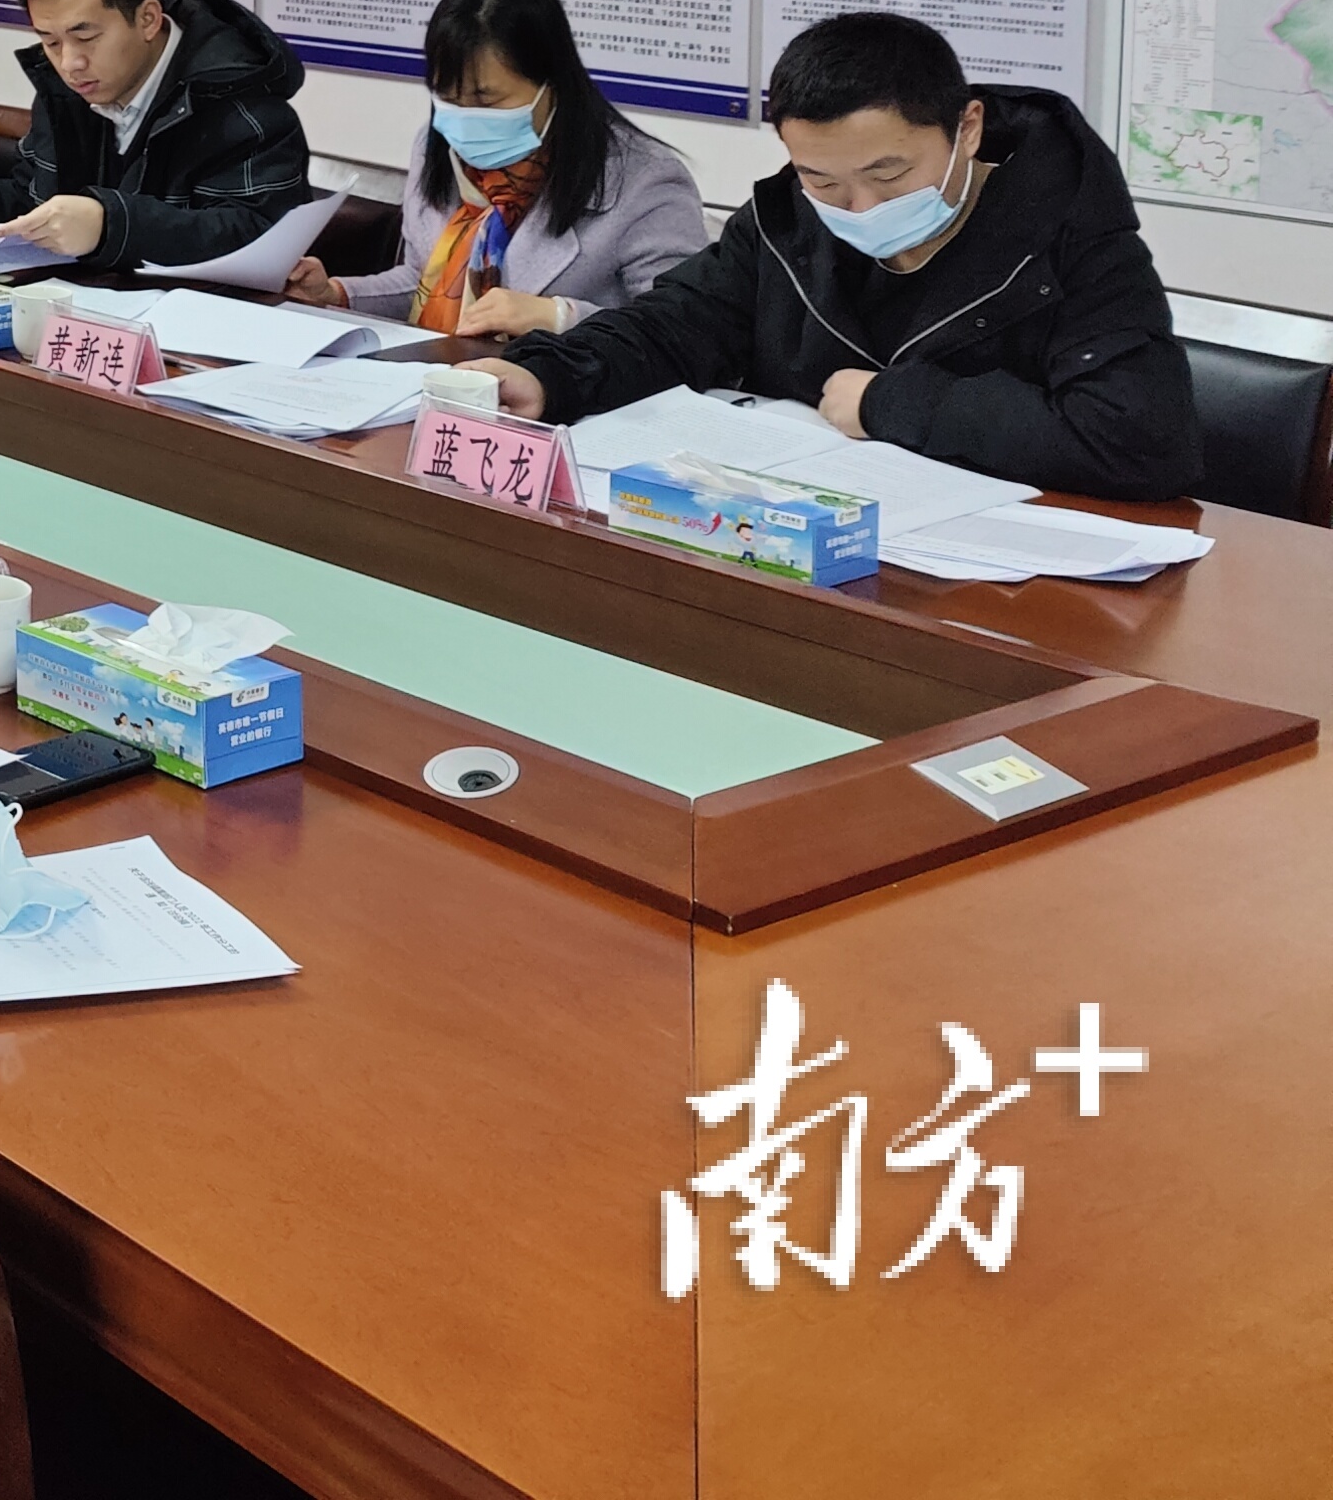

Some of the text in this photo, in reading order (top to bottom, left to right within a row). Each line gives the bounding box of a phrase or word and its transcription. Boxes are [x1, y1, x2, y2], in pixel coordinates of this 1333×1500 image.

[47, 326, 125, 386] 黄新连
[423, 422, 535, 498] 蓝飞龙
[218, 707, 284, 735] 英德市唯一节假日
[230, 725, 272, 747] 营业的银行
